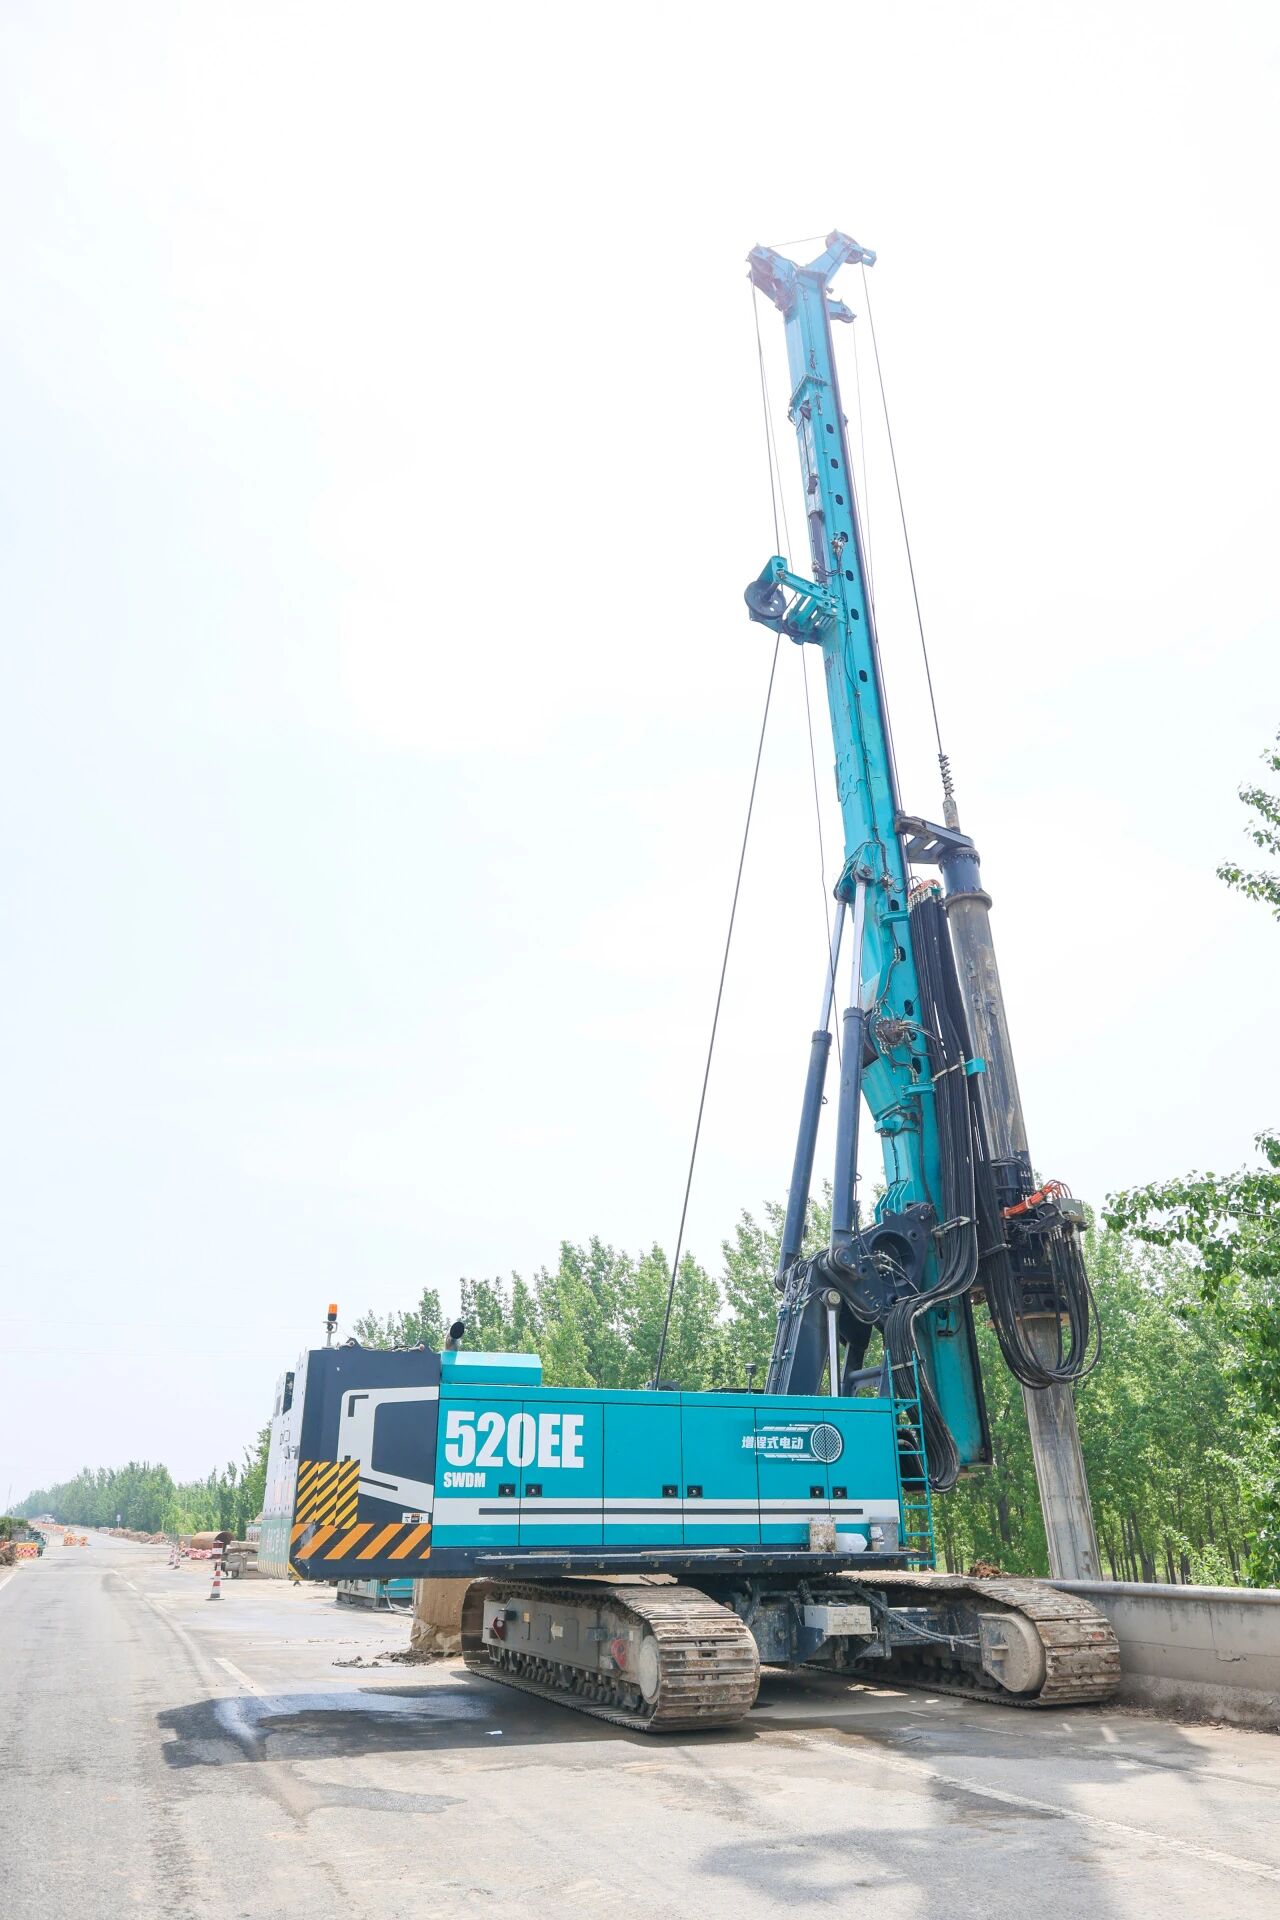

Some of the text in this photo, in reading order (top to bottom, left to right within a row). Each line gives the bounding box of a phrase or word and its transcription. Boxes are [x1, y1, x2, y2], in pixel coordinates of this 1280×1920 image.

[445, 1411, 584, 1468] 520EE
[741, 1436, 804, 1450] 增程式电动
[443, 1472, 486, 1488] SWDM
